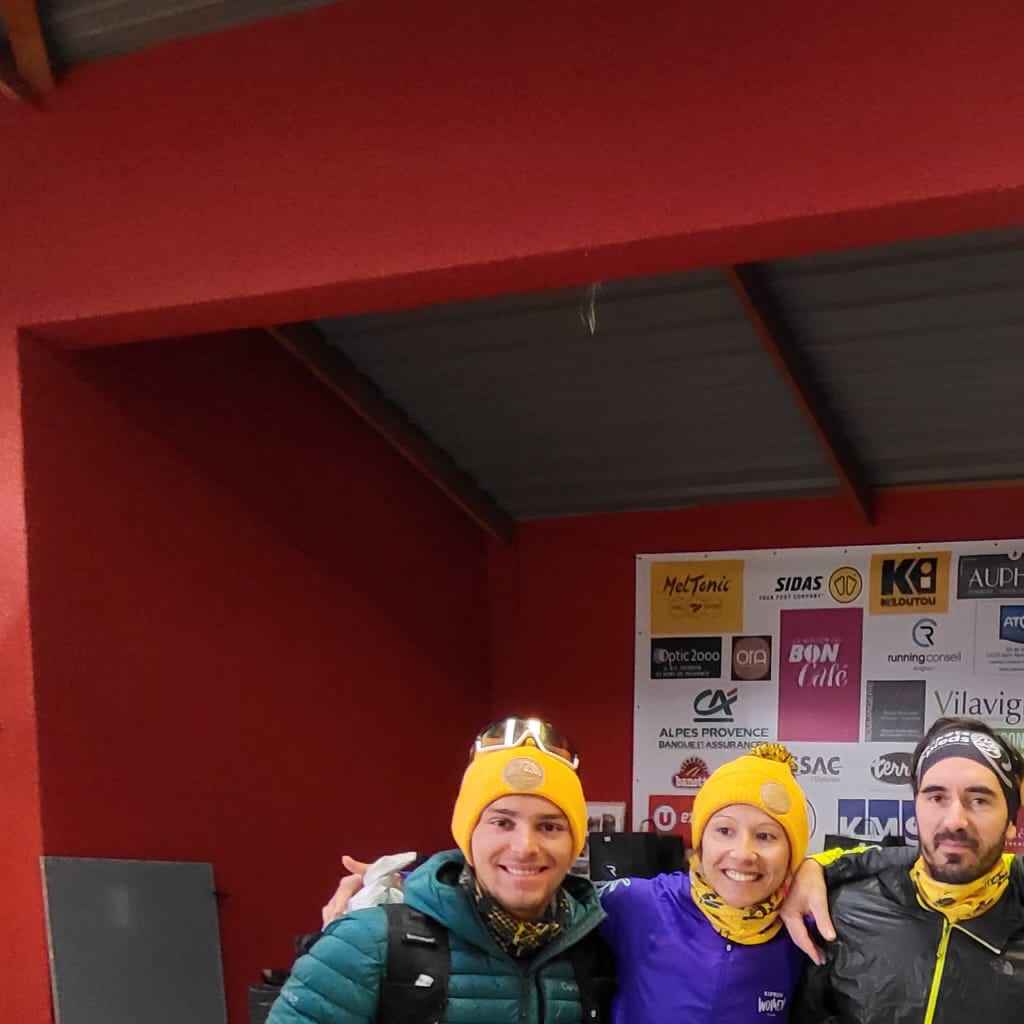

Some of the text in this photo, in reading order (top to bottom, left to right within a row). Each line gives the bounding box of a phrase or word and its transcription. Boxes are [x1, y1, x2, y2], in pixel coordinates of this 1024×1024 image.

[663, 573, 729, 597] MelTonic
[774, 575, 824, 592] SIDAS
[690, 649, 720, 662] 2000
[788, 642, 841, 665] BON
[659, 727, 769, 738] ALPES PROVENCE
